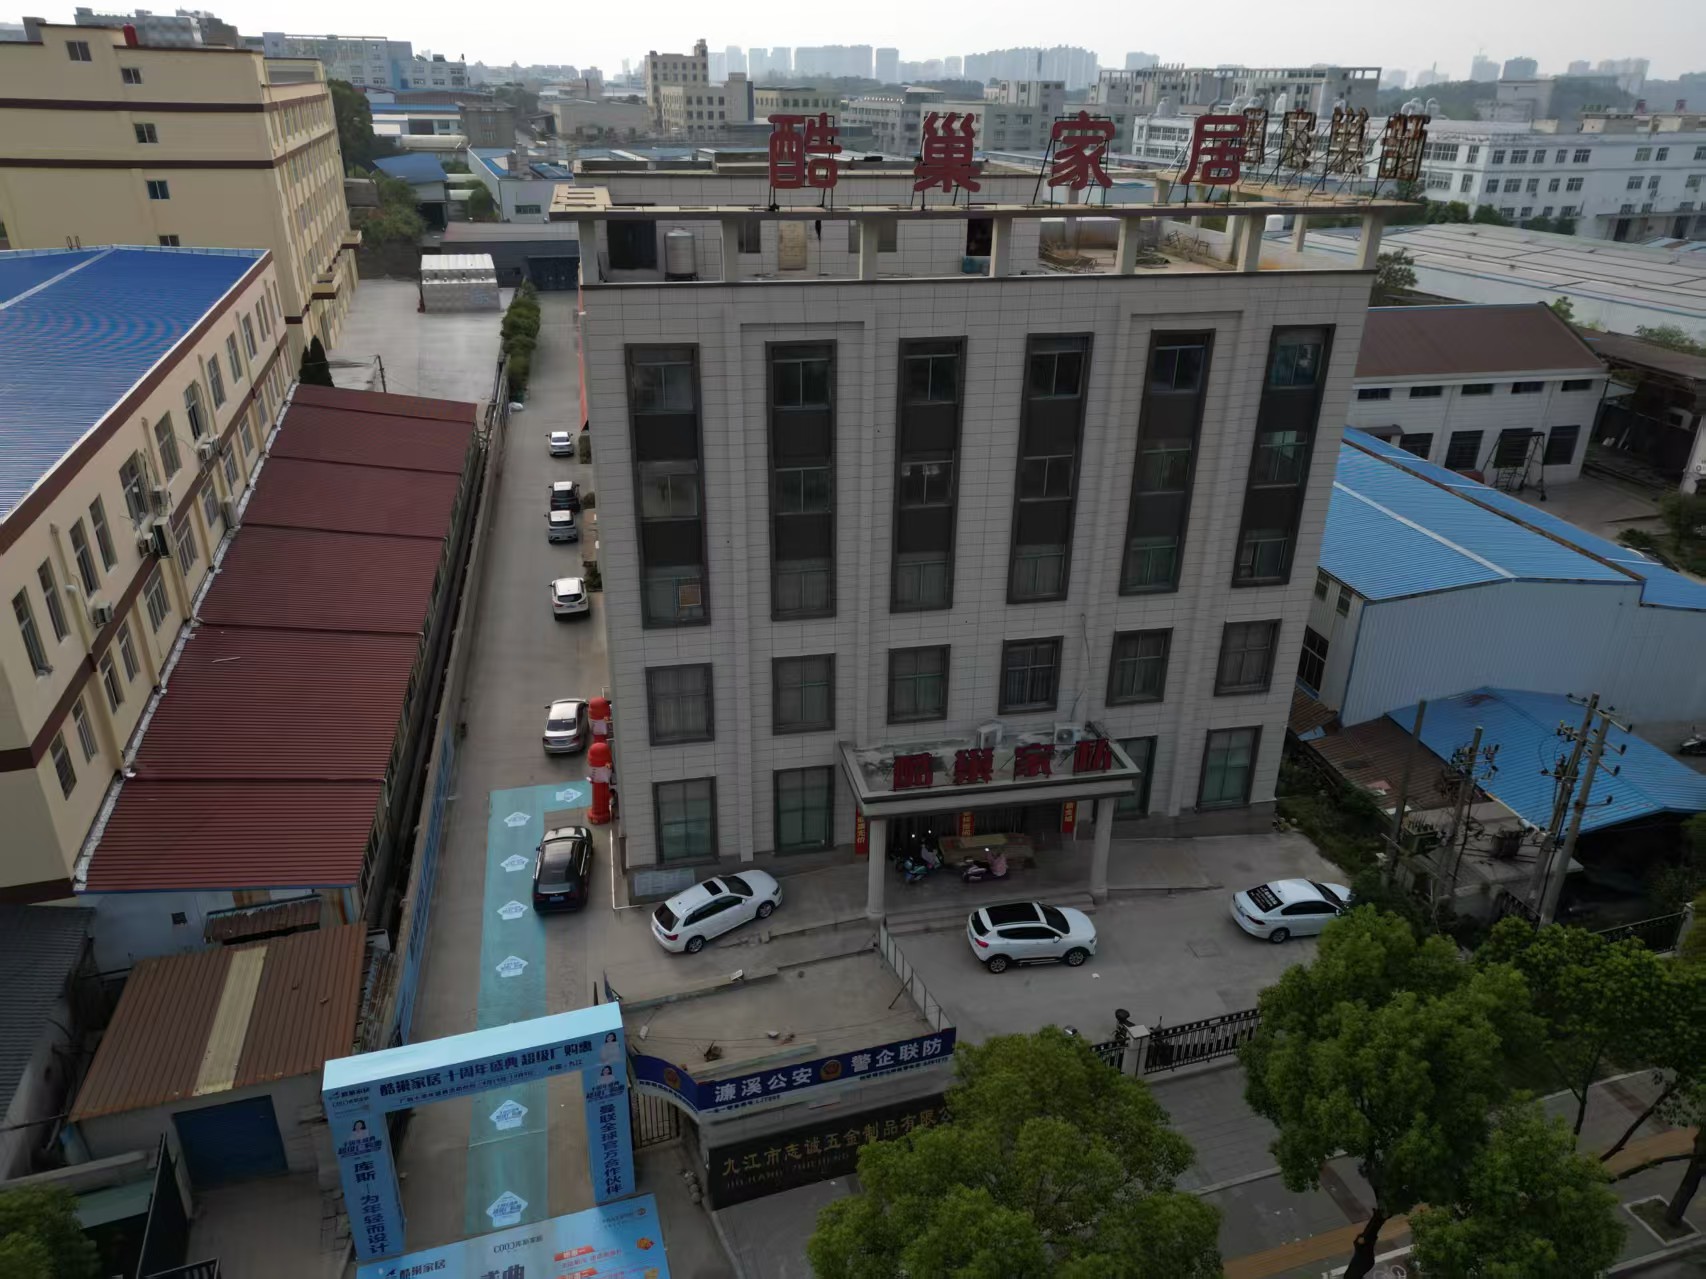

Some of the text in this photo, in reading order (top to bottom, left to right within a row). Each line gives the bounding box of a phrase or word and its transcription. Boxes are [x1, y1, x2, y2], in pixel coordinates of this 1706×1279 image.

[768, 111, 1247, 193] 酷巢家居
[714, 1067, 813, 1103] 濂溪公安
[851, 1038, 943, 1073] 警企联防
